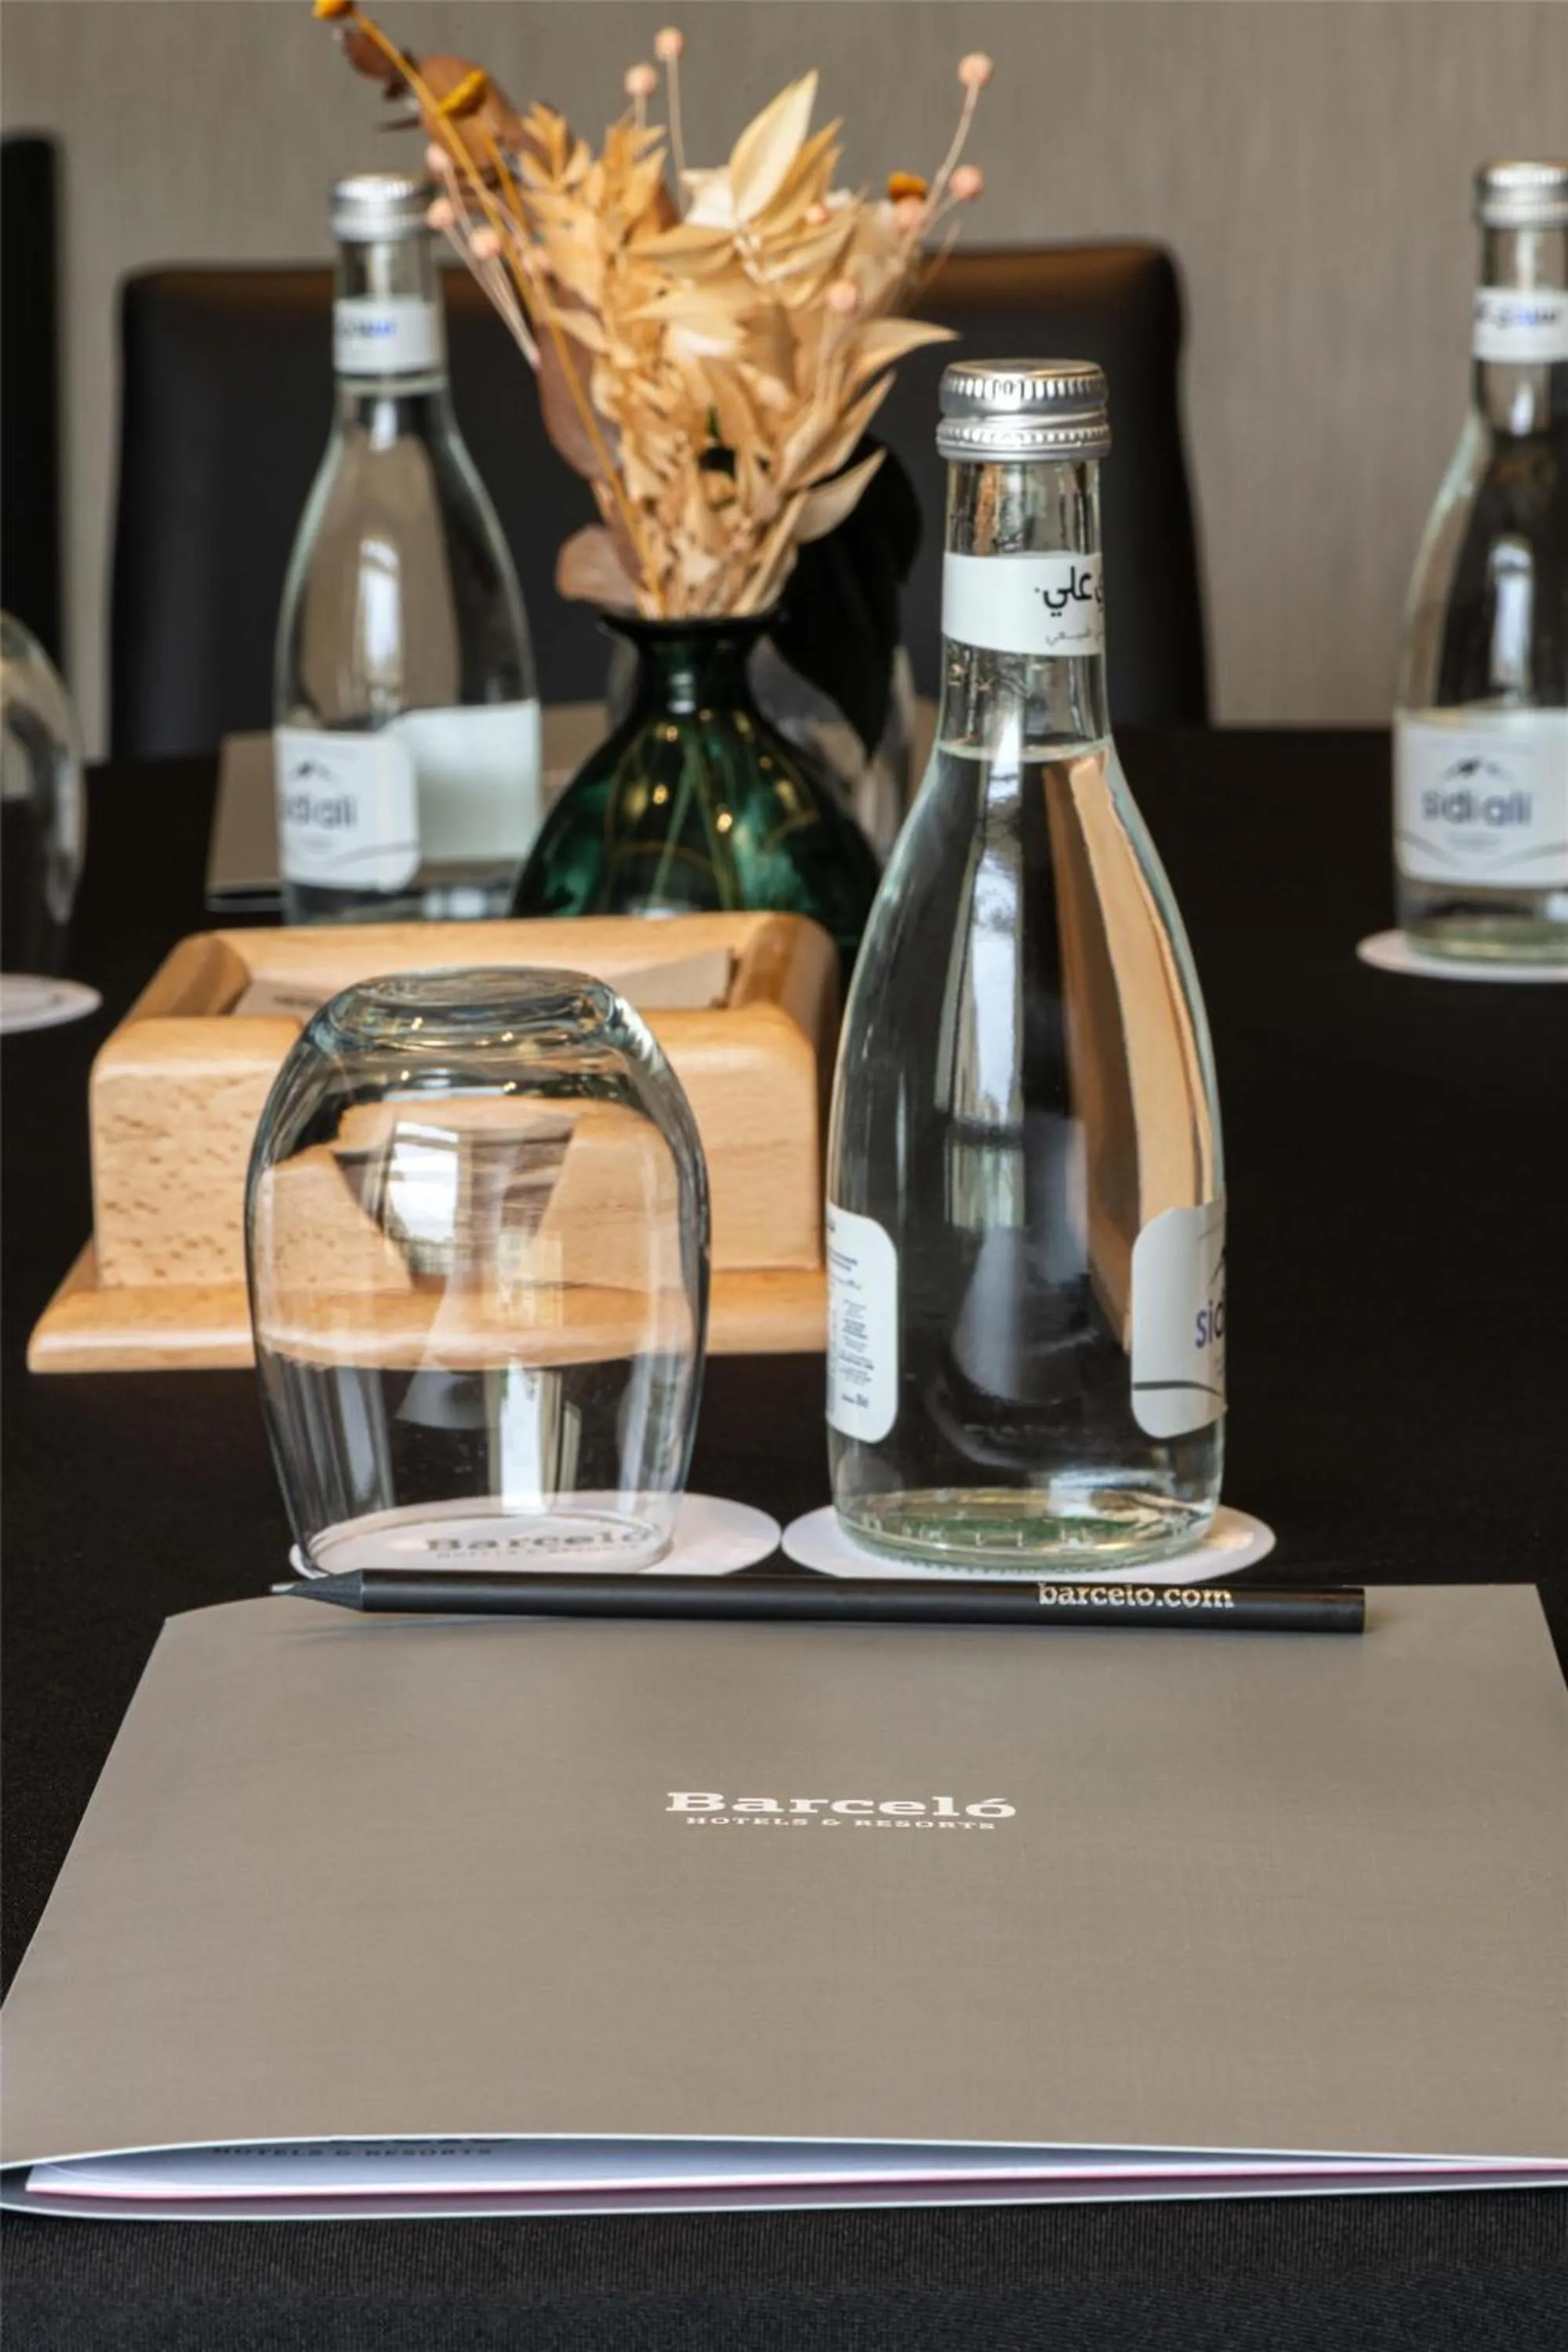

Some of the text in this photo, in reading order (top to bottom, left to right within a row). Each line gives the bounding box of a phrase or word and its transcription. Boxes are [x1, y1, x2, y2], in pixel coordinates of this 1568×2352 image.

[1038, 1581, 1235, 1608] barcelo.com
[665, 1791, 1017, 1818] Barceló
[686, 1817, 995, 1830] HOTELS & RESORTS
